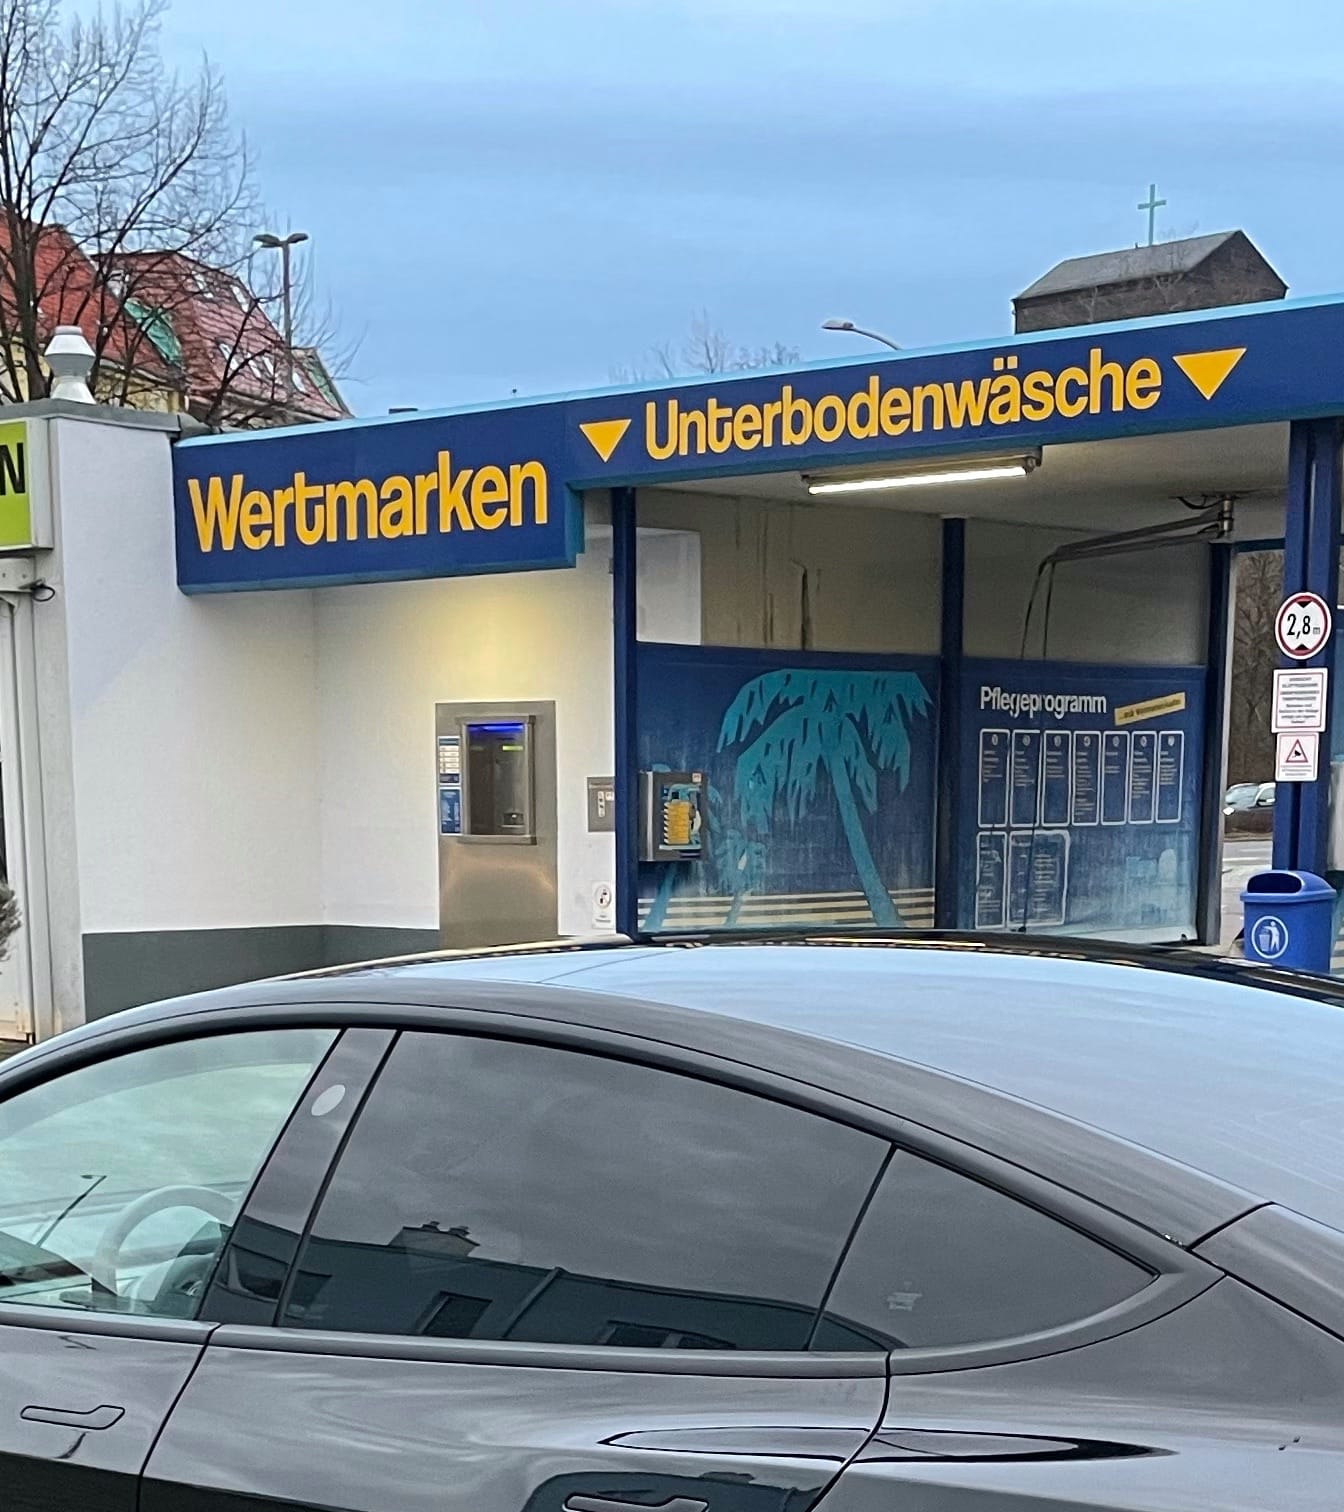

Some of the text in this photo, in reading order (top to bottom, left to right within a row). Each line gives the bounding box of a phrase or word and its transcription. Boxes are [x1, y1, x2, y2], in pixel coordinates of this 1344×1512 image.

[644, 347, 1162, 461] Unterbodenwäsche
[187, 450, 549, 553] Wertmarken
[1286, 613, 1311, 639] 2,8
[980, 686, 1107, 720] Pflegeprogramm
